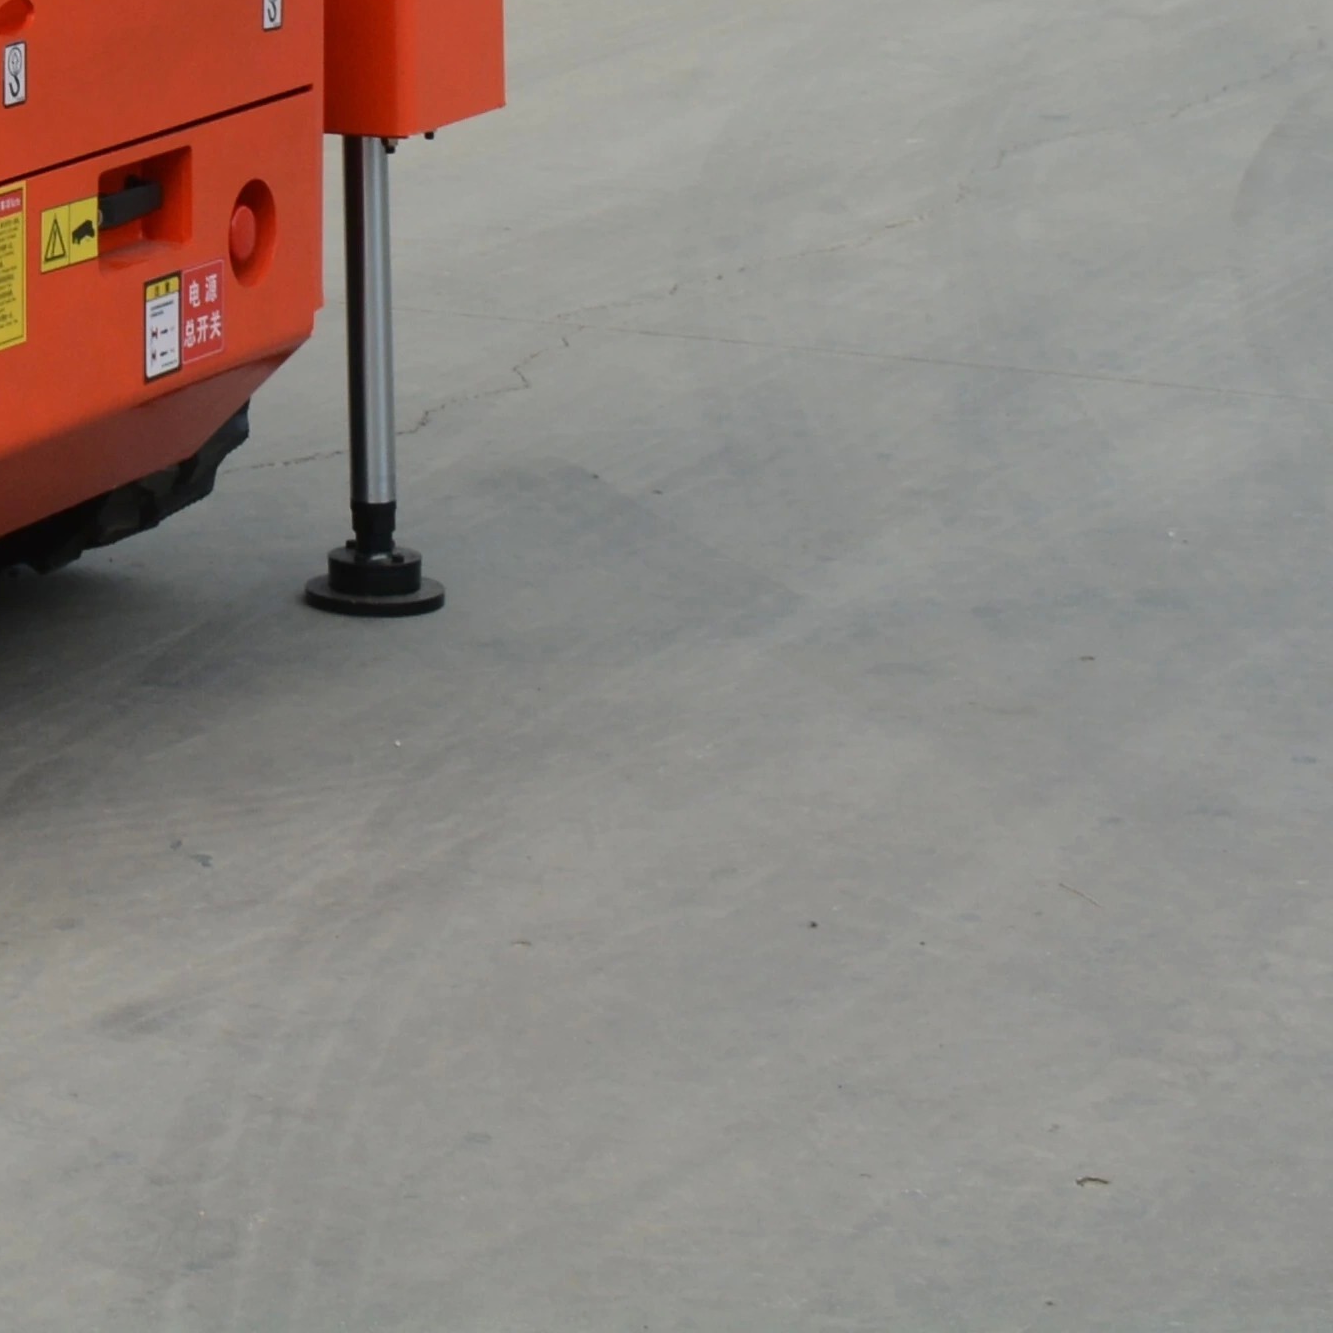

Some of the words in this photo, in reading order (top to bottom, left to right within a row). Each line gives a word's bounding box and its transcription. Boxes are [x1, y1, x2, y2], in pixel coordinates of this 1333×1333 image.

[189, 273, 218, 308] 电源
[184, 310, 222, 349] 总开关
